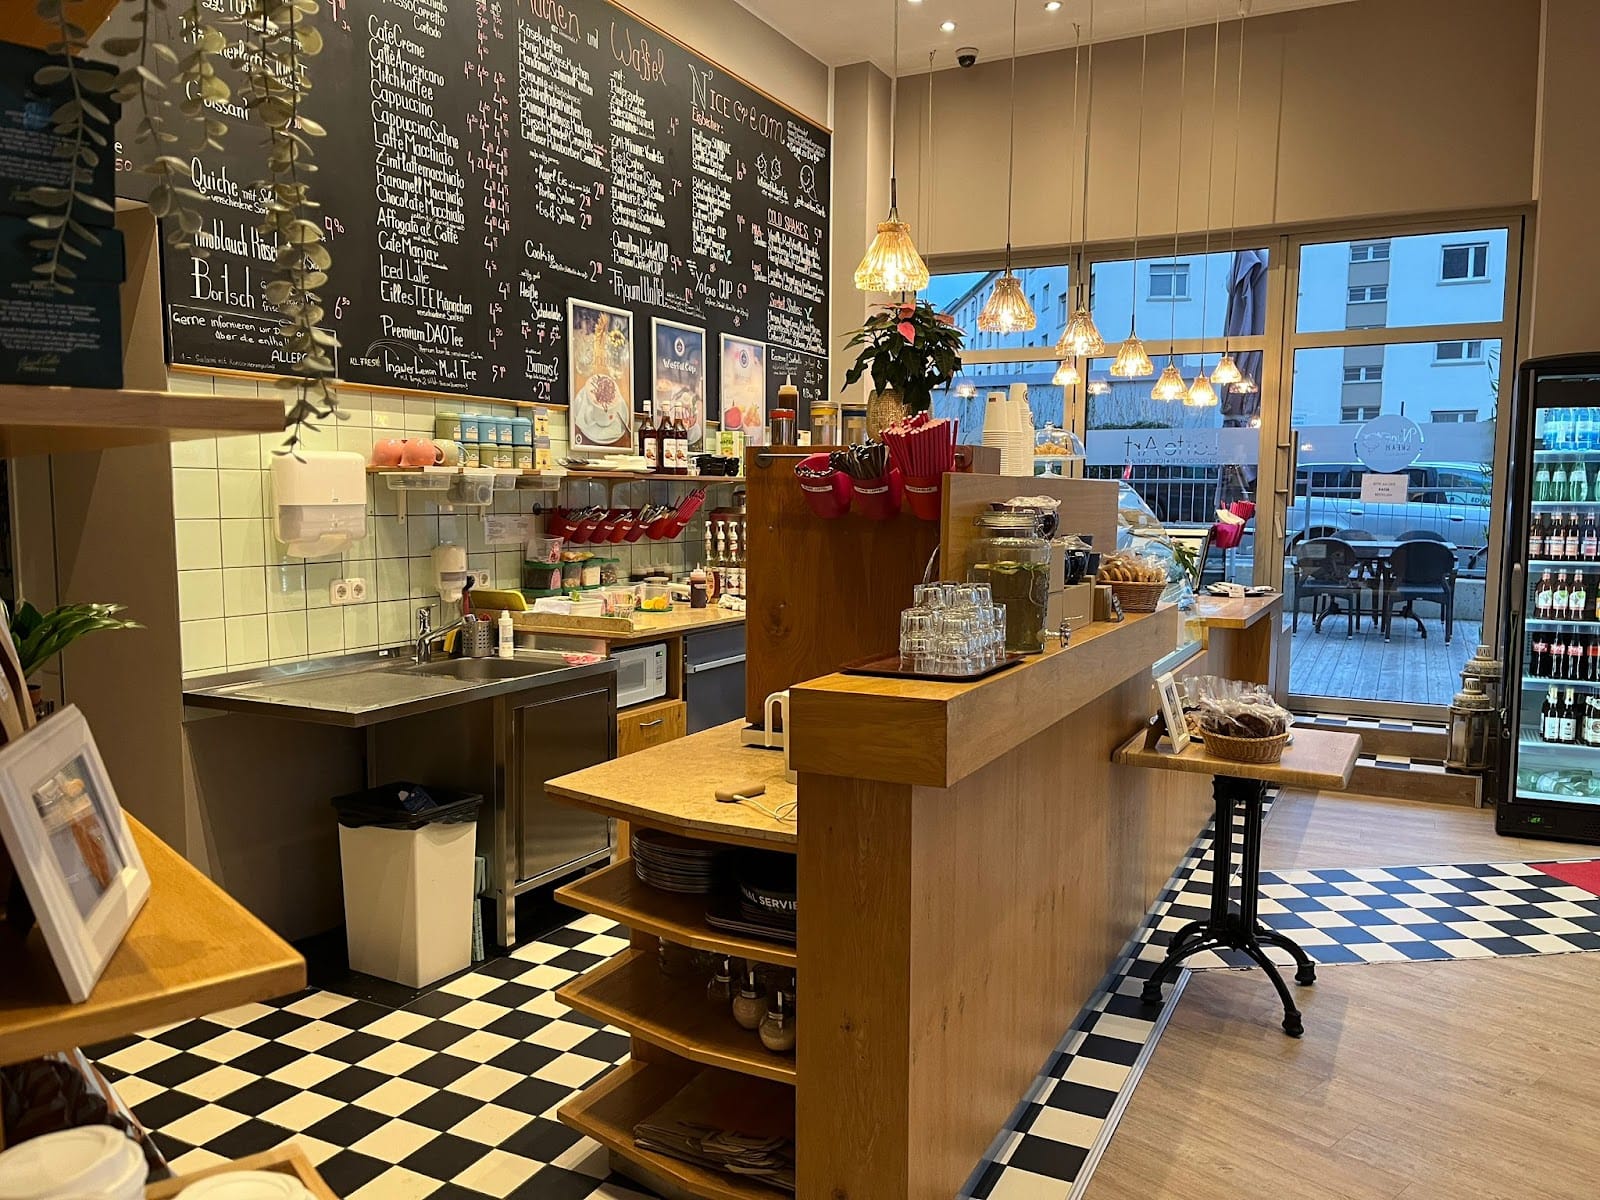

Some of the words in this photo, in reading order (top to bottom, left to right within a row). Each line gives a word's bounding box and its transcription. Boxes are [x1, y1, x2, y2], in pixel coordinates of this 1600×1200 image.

[530, 0, 581, 39] uchen
[611, 21, 667, 86] Waffel
[370, 79, 433, 118] Cappuccino
[371, 100, 432, 140] Cappuccino
[191, 157, 238, 196] Quiche
[376, 165, 422, 195] Karamell
[423, 178, 464, 207] Macchiato
[376, 184, 425, 213] Chocolate
[377, 206, 419, 236] Affogato
[420, 221, 432, 238] al
[380, 253, 404, 280] Iced
[525, 239, 554, 262] Cookie
[172, 312, 206, 327] Gerne
[380, 314, 426, 341] Premium
[449, 325, 464, 348] Tee
[460, 360, 477, 380] Tee
